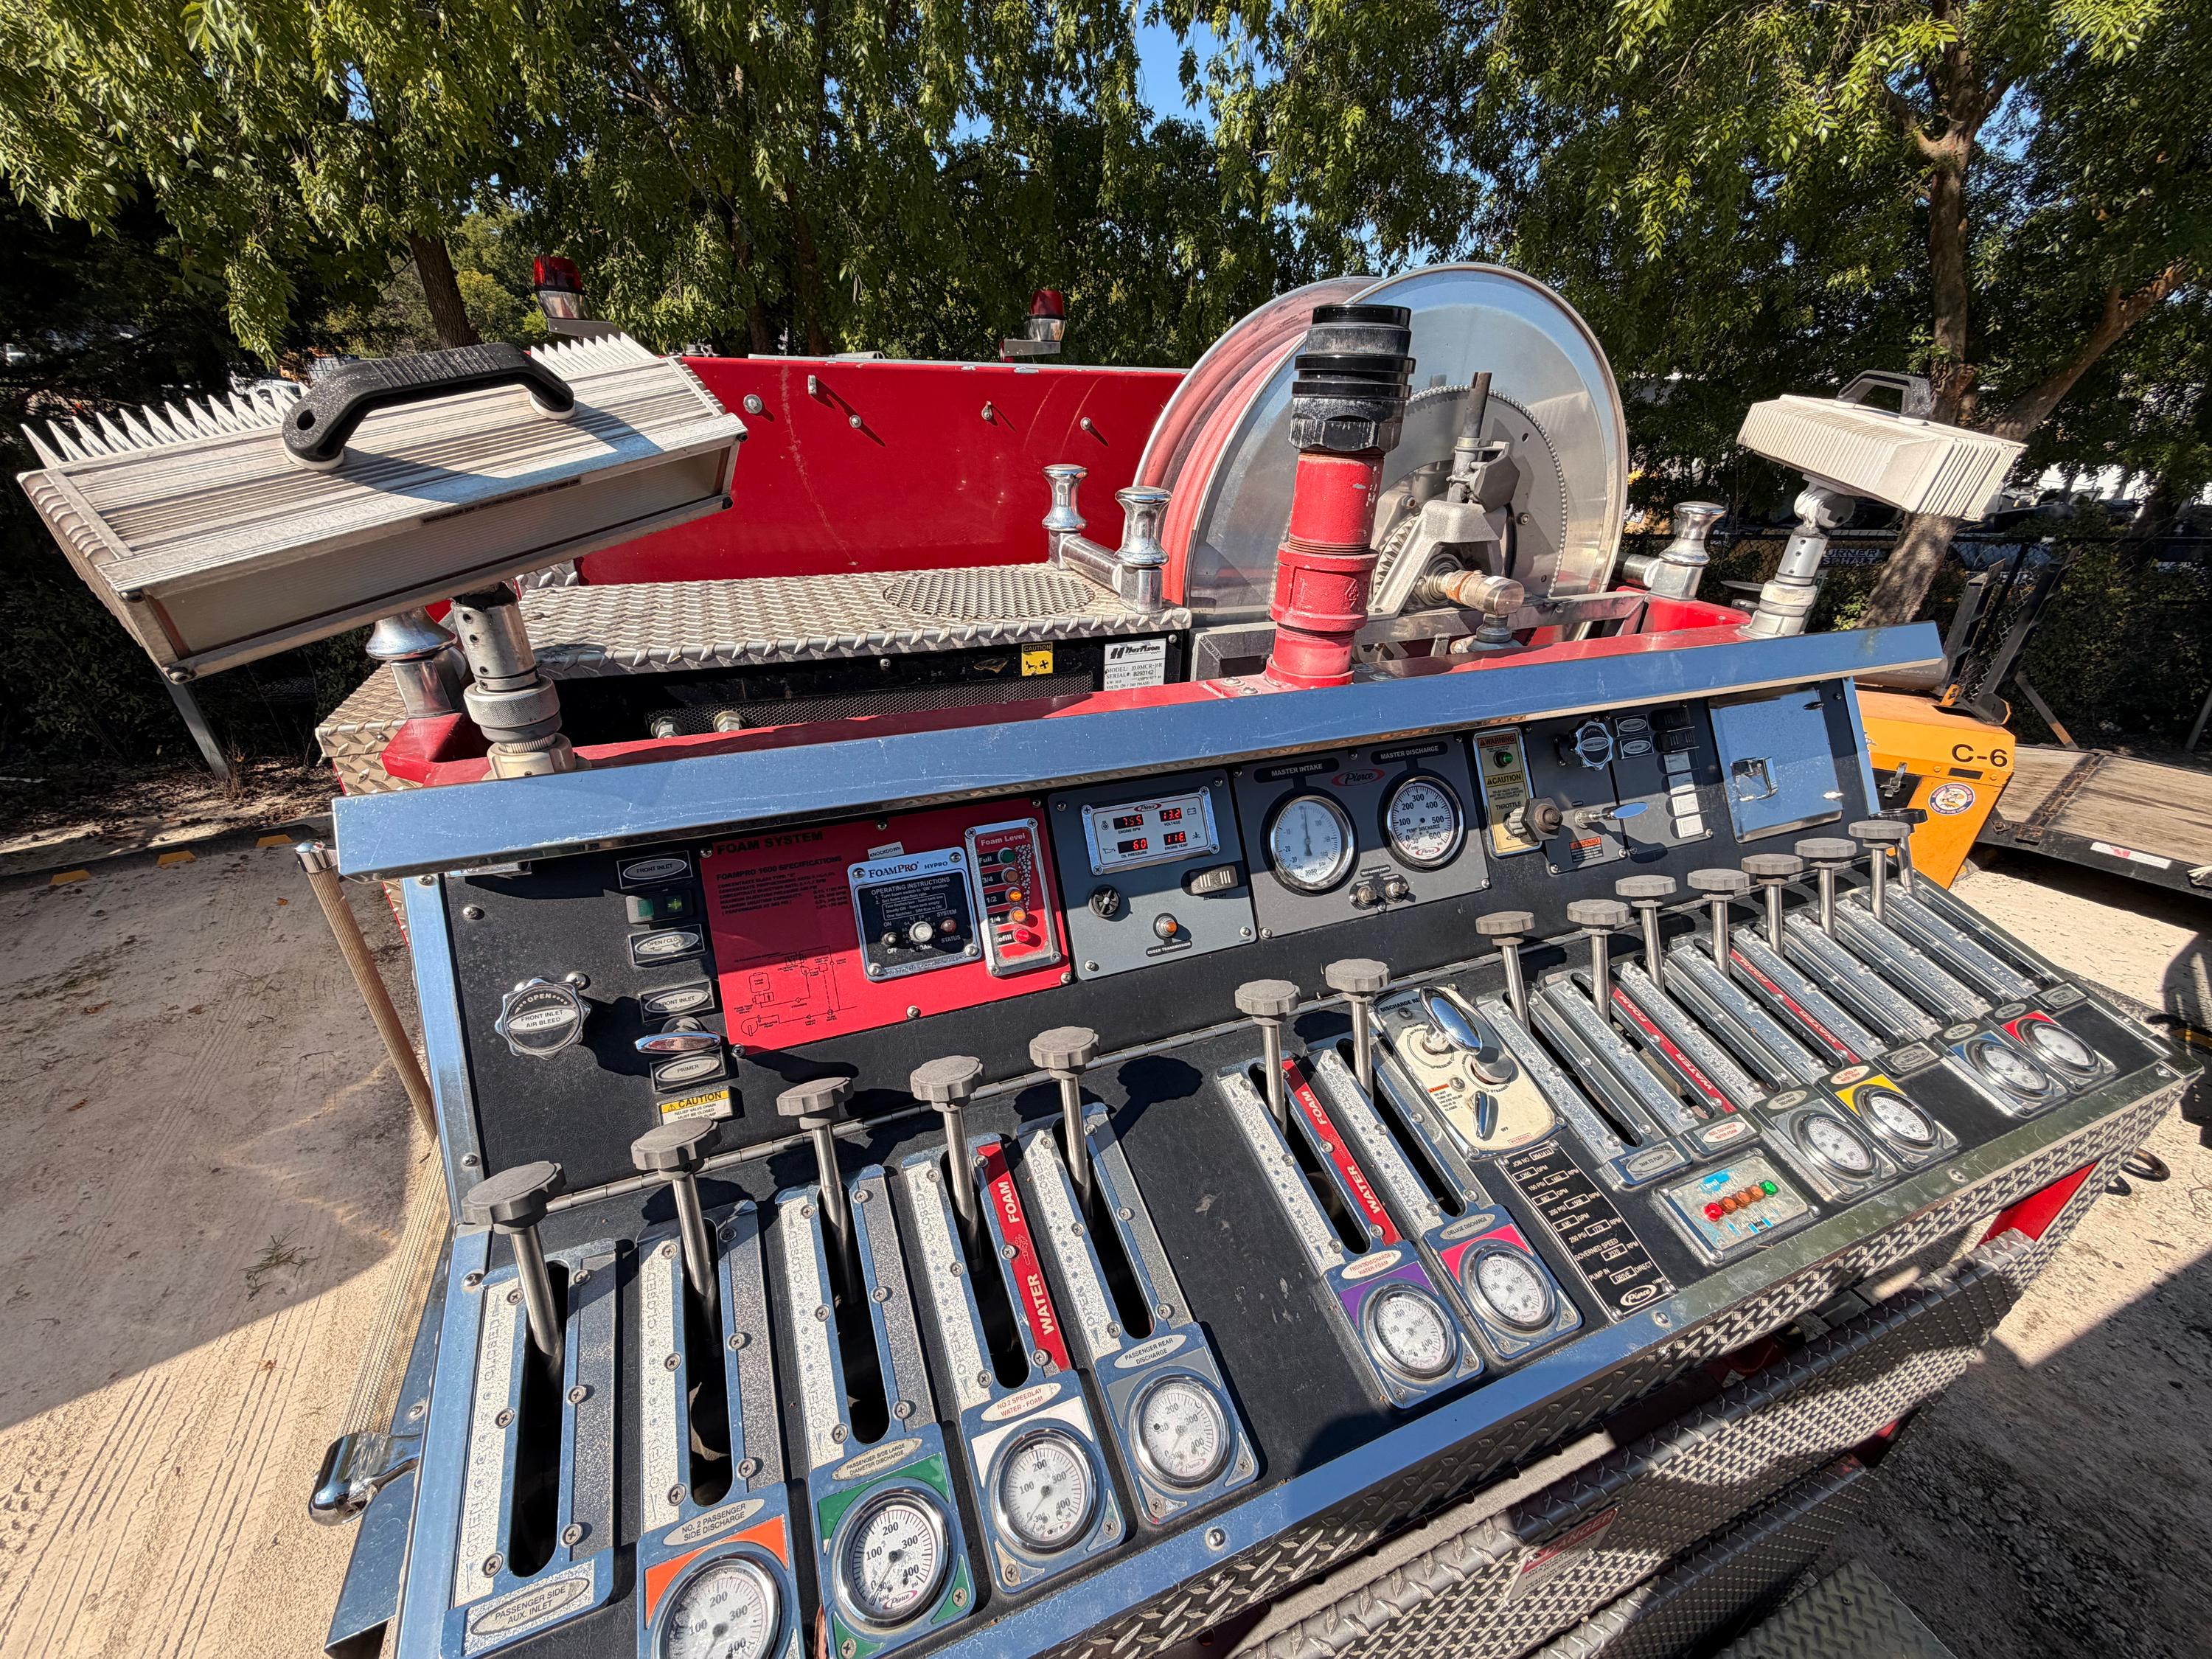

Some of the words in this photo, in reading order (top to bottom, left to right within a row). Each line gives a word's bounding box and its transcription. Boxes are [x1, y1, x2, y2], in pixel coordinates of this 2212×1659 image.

[1826, 549, 1878, 557] URNER
[1023, 644, 1051, 652] CAUTION
[1485, 735, 1515, 745] WARNING
[1380, 751, 1405, 759] MASTER
[1405, 745, 1439, 757] DISCHARGE
[1950, 742, 2009, 768] C-6
[1271, 765, 1297, 776] MASTER
[1298, 762, 1324, 773] INTAKE
[1492, 773, 1522, 785] CAUTION
[1411, 793, 1425, 802] 300
[1401, 802, 1414, 811] 200
[1425, 801, 1438, 809] 400
[1495, 801, 1522, 810] THROTTLE
[1399, 817, 1411, 826] 100
[1431, 815, 1444, 824] 500
[1418, 824, 1441, 832] DISCHARGE
[717, 839, 760, 855] FOAM
[764, 830, 824, 849] SYSTEM
[981, 837, 1003, 846] Foam
[1004, 833, 1026, 842] Level
[1428, 831, 1441, 840] 600
[869, 846, 902, 858] KNOCKDOWN
[1133, 839, 1147, 850] 60
[924, 860, 948, 869] HYPRO
[978, 855, 992, 863] Full
[636, 866, 655, 874] FRONT
[716, 868, 756, 880] FOAMPRO
[778, 855, 843, 872] SPECIFICATIONS
[871, 883, 907, 896] OPERATING
[907, 876, 950, 889] INSTRUCTIONS
[936, 909, 957, 917] SYSTEM
[647, 939, 662, 947] OPEN
[941, 935, 961, 943] STATUS
[1739, 958, 1770, 984] FOAM
[527, 992, 552, 1003] OPEN
[658, 998, 678, 1007] FRONT
[678, 995, 695, 1004] INLET
[1380, 998, 1409, 1012] DISCHARGE
[521, 1012, 543, 1022] FRONT
[544, 1009, 563, 1018] INLET
[1618, 994, 1649, 1023] FOAM
[526, 1020, 538, 1028] AIR
[538, 1017, 561, 1026] BLEED
[1798, 1010, 1838, 1044] WATER
[677, 1064, 700, 1073] PRIMER
[1674, 1052, 1714, 1091] WATER
[678, 1091, 722, 1108] CAUTION
[697, 1107, 715, 1116] CLOSED
[1301, 1090, 1327, 1125] FOAM
[1536, 1164, 1549, 1172] GPM
[1528, 1183, 1537, 1192] 150
[1568, 1168, 1580, 1176] RPM
[1346, 1165, 1381, 1214] WATER
[1557, 1188, 1569, 1196] GPM
[998, 1180, 1020, 1224] FOAM
[1548, 1208, 1559, 1217] 200
[1557, 1205, 1567, 1213] PSI
[1588, 1191, 1601, 1200] RPM
[1577, 1212, 1590, 1222] GPM
[1447, 1225, 1465, 1236] DELUGE
[1464, 1216, 1487, 1230] DISCHARGE
[1568, 1235, 1579, 1244] 250
[1578, 1231, 1587, 1239] PSI
[1609, 1217, 1622, 1226] RPM
[1574, 1244, 1602, 1261] GOVERNED
[1601, 1237, 1619, 1249] SPEED
[1626, 1240, 1639, 1250] RPM
[1588, 1270, 1604, 1281] PUMP
[1604, 1267, 1611, 1276] IN
[1615, 1271, 1631, 1283] DRIVE
[1634, 1260, 1653, 1273] DIRECT
[1627, 1288, 1651, 1304] Pierce
[1026, 1273, 1055, 1336] WATER
[1124, 1343, 1158, 1361] PASSENGER
[1158, 1337, 1174, 1349] REAR
[1135, 1348, 1169, 1365] DISCHARGE
[1011, 1388, 1043, 1405] SPEEDLAY
[1000, 1404, 1023, 1417] WATER
[1025, 1395, 1044, 1408] FOAM
[1164, 1402, 1180, 1415] 200
[1184, 1413, 1200, 1426] 300
[846, 1455, 876, 1471] PASSENGER
[876, 1449, 889, 1459] SIDE
[888, 1443, 905, 1455] LARGE
[849, 1460, 874, 1475] DIAMETER
[874, 1449, 905, 1466] DISCHARGE
[1032, 1458, 1048, 1473] 200
[1051, 1470, 1068, 1484] 300
[1018, 1481, 1034, 1495] 100
[1056, 1498, 1071, 1512] 400
[682, 1524, 695, 1534] NO.
[696, 1520, 702, 1528] 2
[703, 1503, 747, 1526] PASSENGER
[684, 1529, 702, 1542] SIDE
[702, 1511, 745, 1534] DISCHARGE
[882, 1522, 900, 1537] 200
[1545, 1511, 1614, 1557] DANGER
[901, 1534, 919, 1549] 300
[865, 1546, 883, 1561] 100
[902, 1564, 920, 1579] 400
[494, 1593, 546, 1621] PASSENGER
[546, 1586, 566, 1599] SIDE
[709, 1590, 728, 1608] 200
[507, 1612, 527, 1624] AUX.
[529, 1599, 554, 1615] INLET
[728, 1604, 748, 1622] 300
[689, 1618, 708, 1637] 100
[726, 1637, 747, 1655] 400
